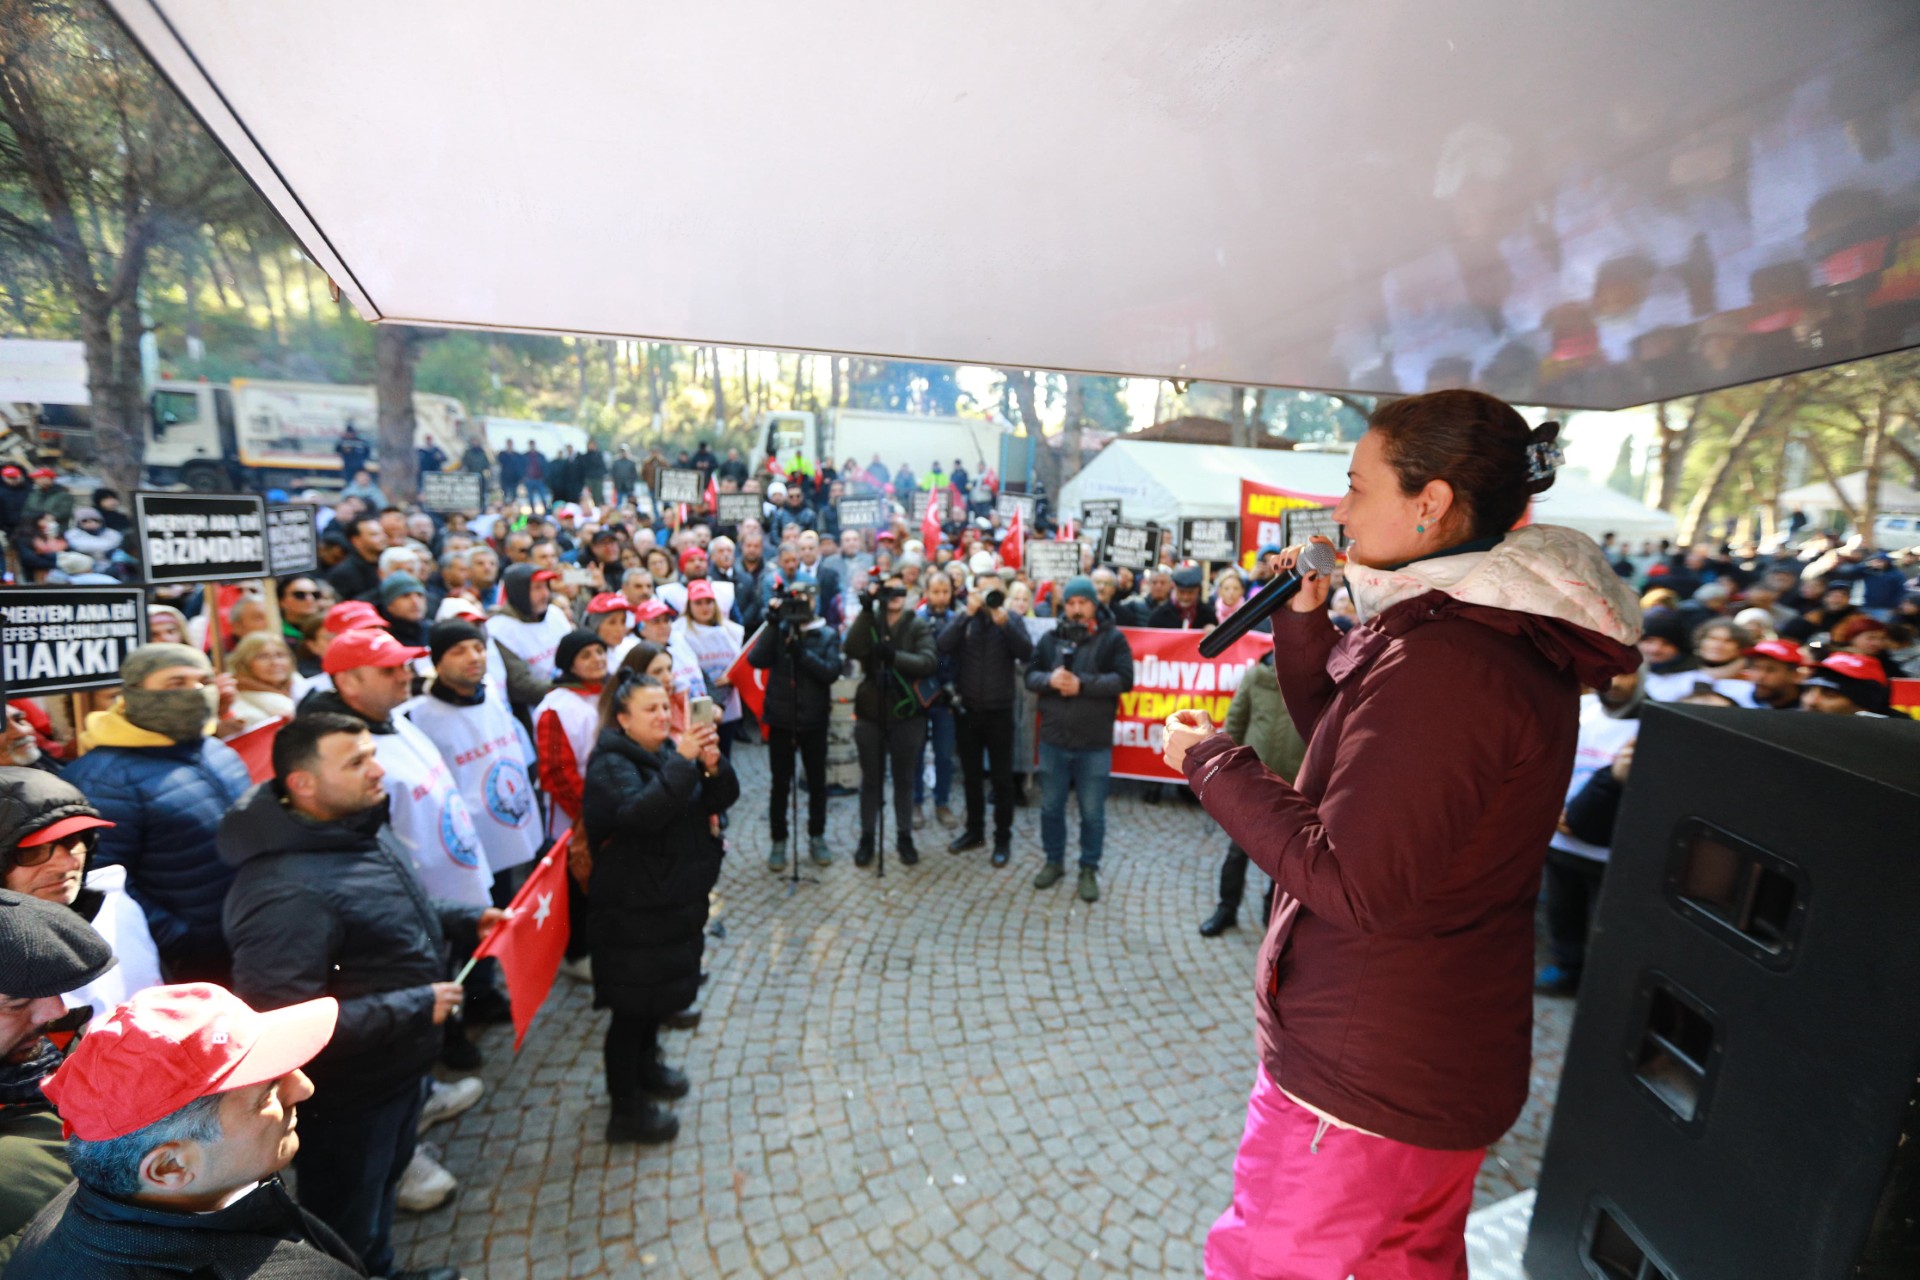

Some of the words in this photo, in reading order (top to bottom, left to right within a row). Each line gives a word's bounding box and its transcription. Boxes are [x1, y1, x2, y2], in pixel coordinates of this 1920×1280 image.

[149, 531, 264, 566] BİZİMDİR!
[1, 604, 74, 624] MERYEM
[76, 603, 110, 622] ANA
[3, 625, 38, 642] EFES
[3, 638, 119, 681] HAKKI
